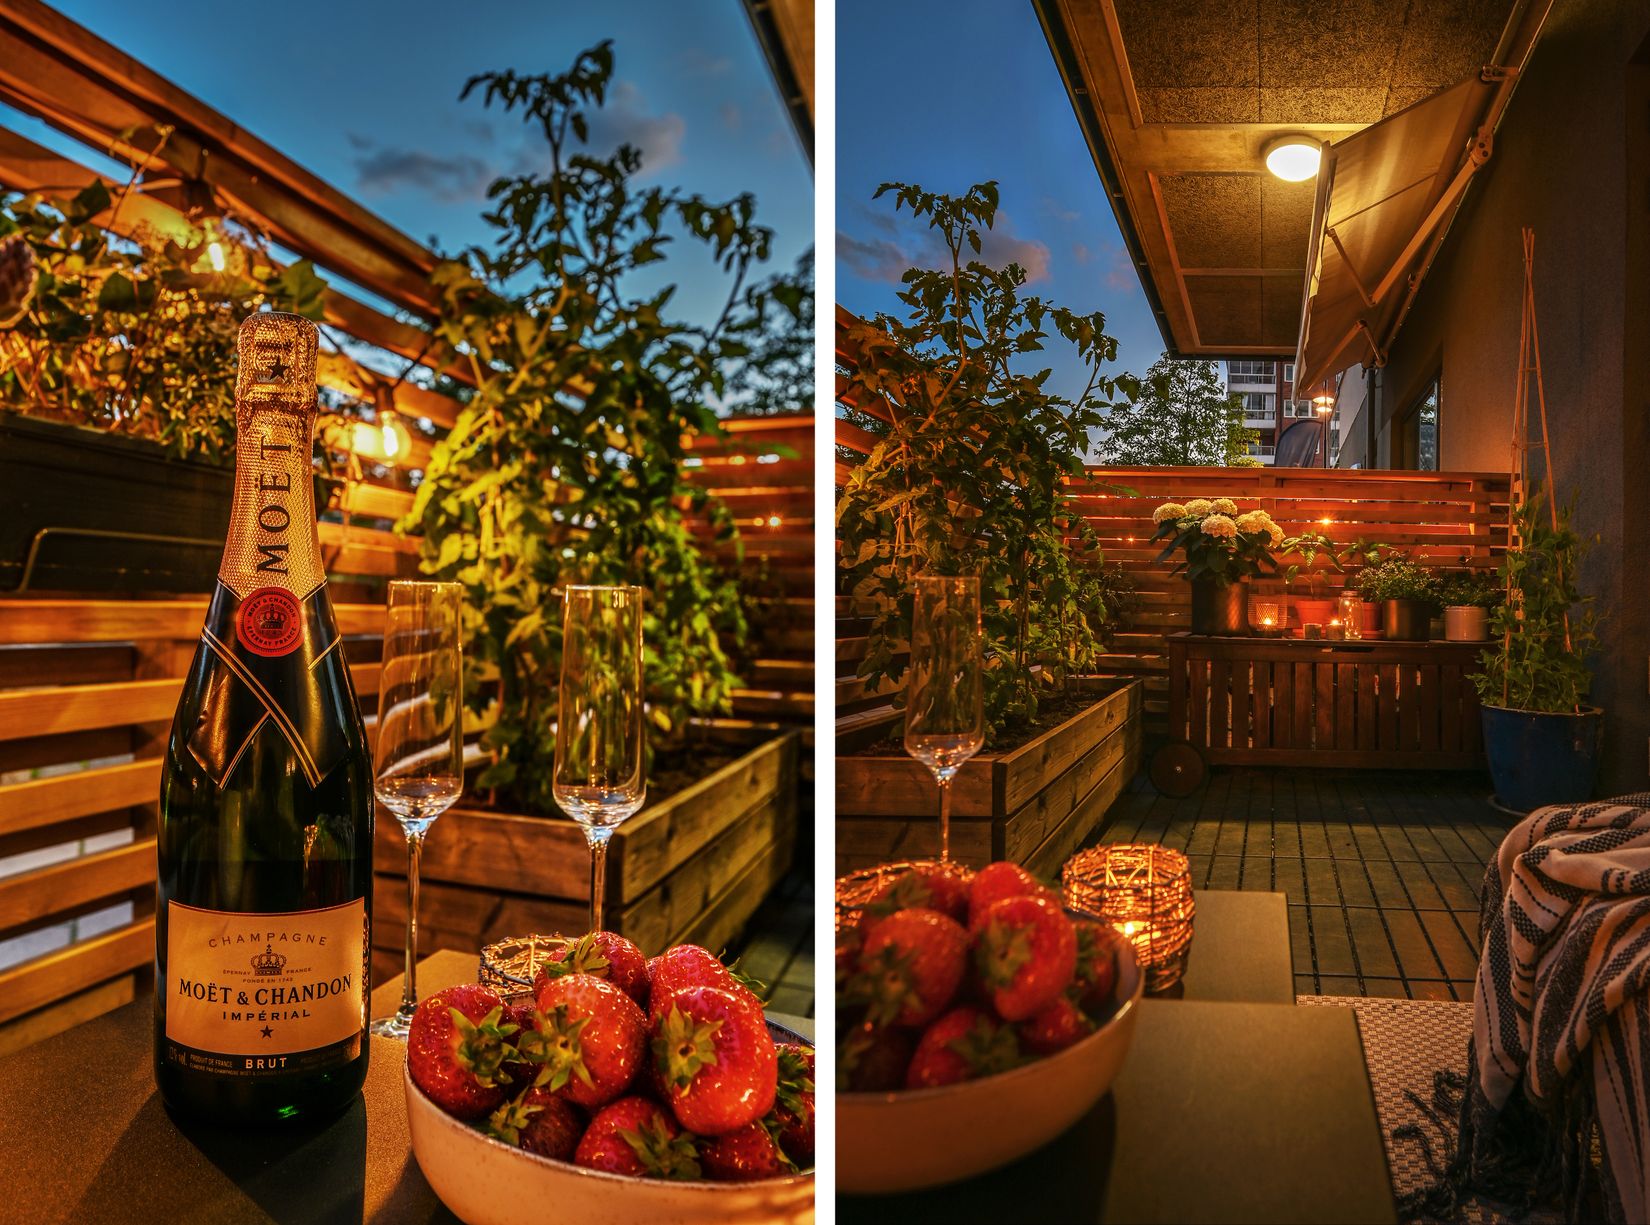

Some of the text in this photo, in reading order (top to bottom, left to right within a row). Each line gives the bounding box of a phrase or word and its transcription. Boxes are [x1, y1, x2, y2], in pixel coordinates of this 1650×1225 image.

[254, 435, 291, 575] MOËT
[209, 932, 327, 948] CHAMPAGNE
[180, 973, 352, 1005] MOËT & CHANDON
[223, 1010, 310, 1021] IMPÉRIAL
[246, 1057, 287, 1069] BRUT
